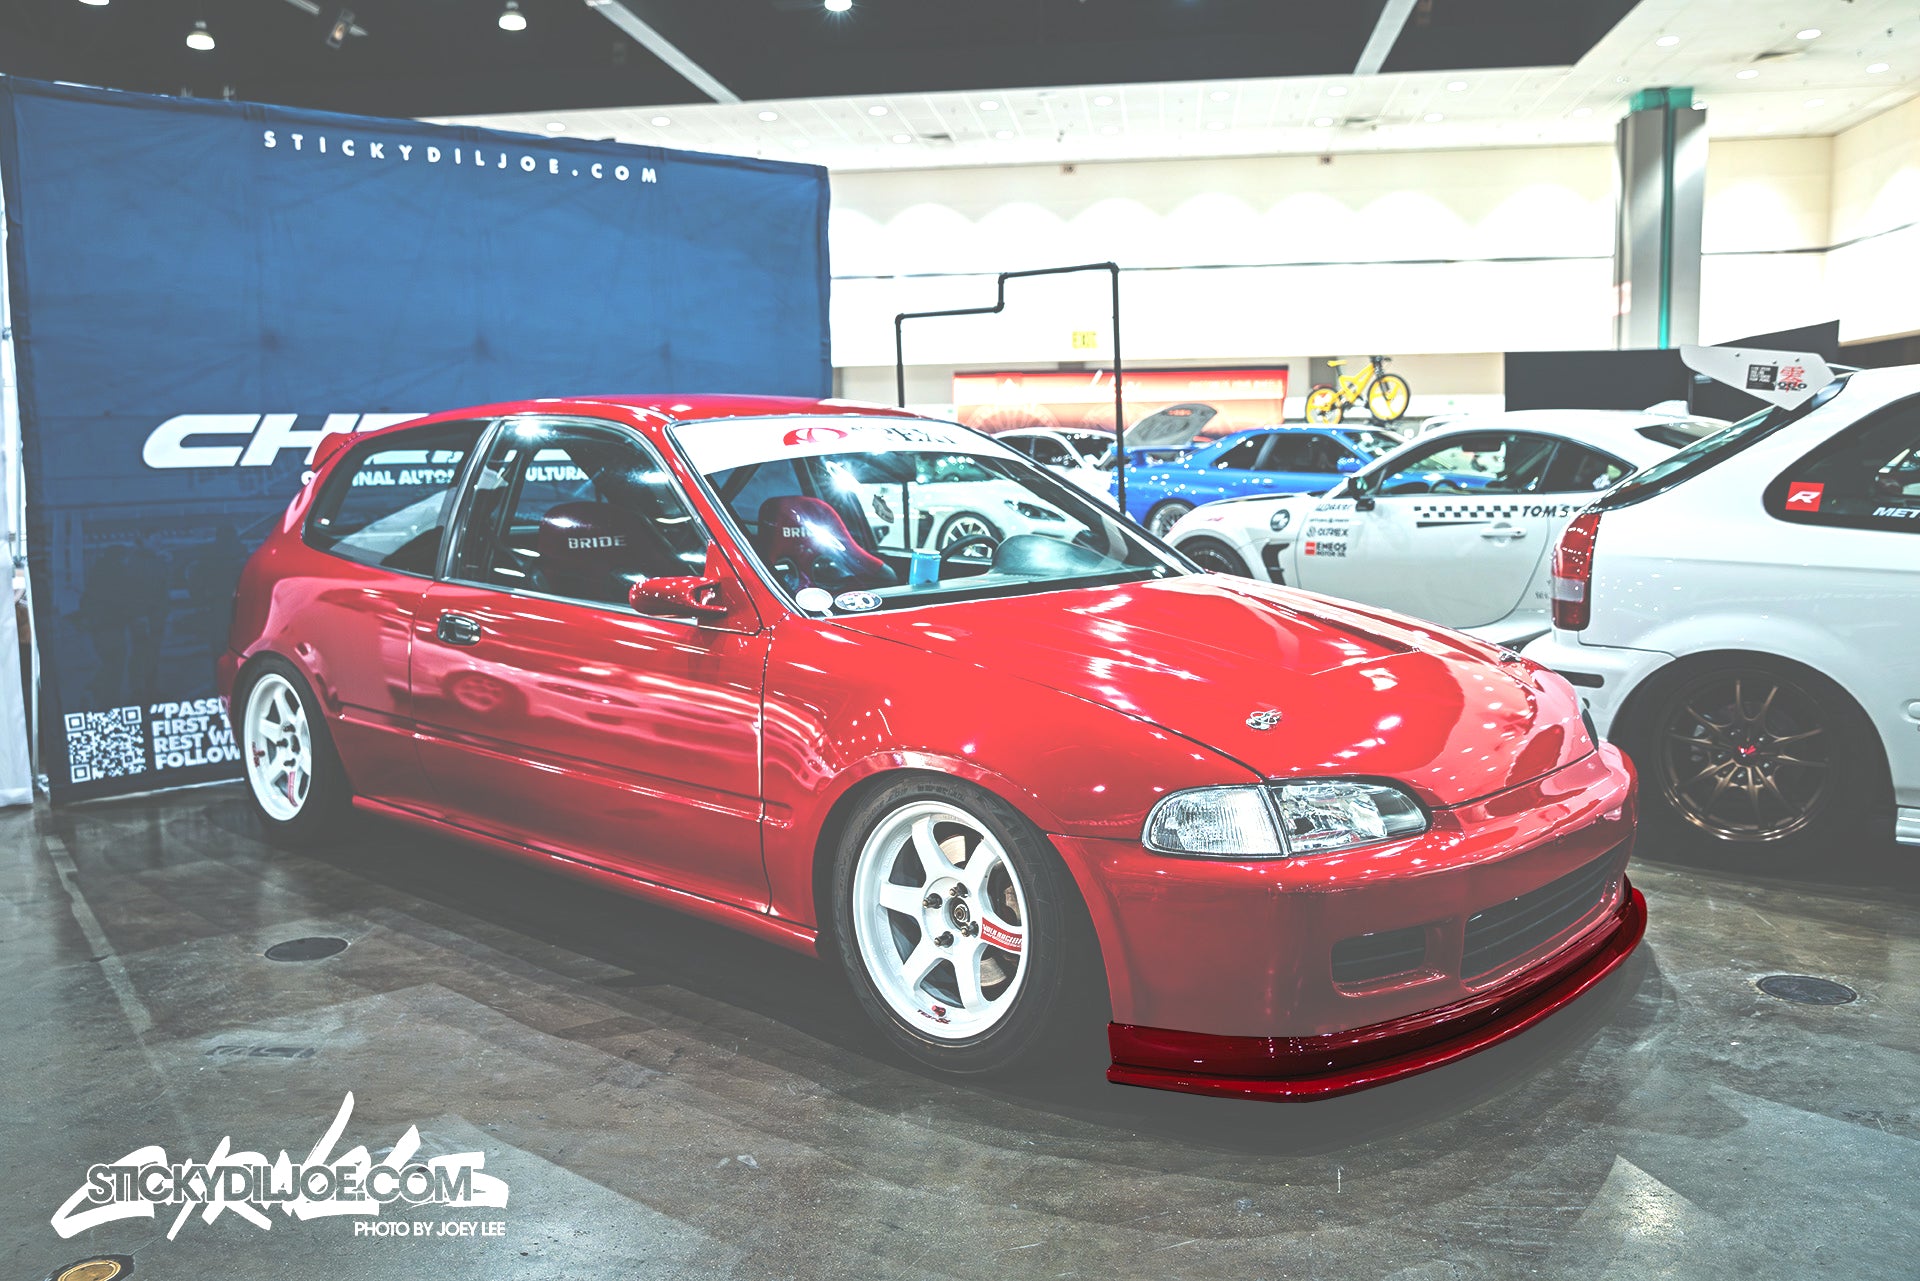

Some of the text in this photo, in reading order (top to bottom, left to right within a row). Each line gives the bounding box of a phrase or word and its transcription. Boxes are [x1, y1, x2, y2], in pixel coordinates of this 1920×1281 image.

[262, 130, 658, 185] STICKYDILJOE.COM
[568, 535, 626, 549] BRIDE
[1316, 541, 1347, 551] ENEOS
[154, 732, 204, 753] REST
